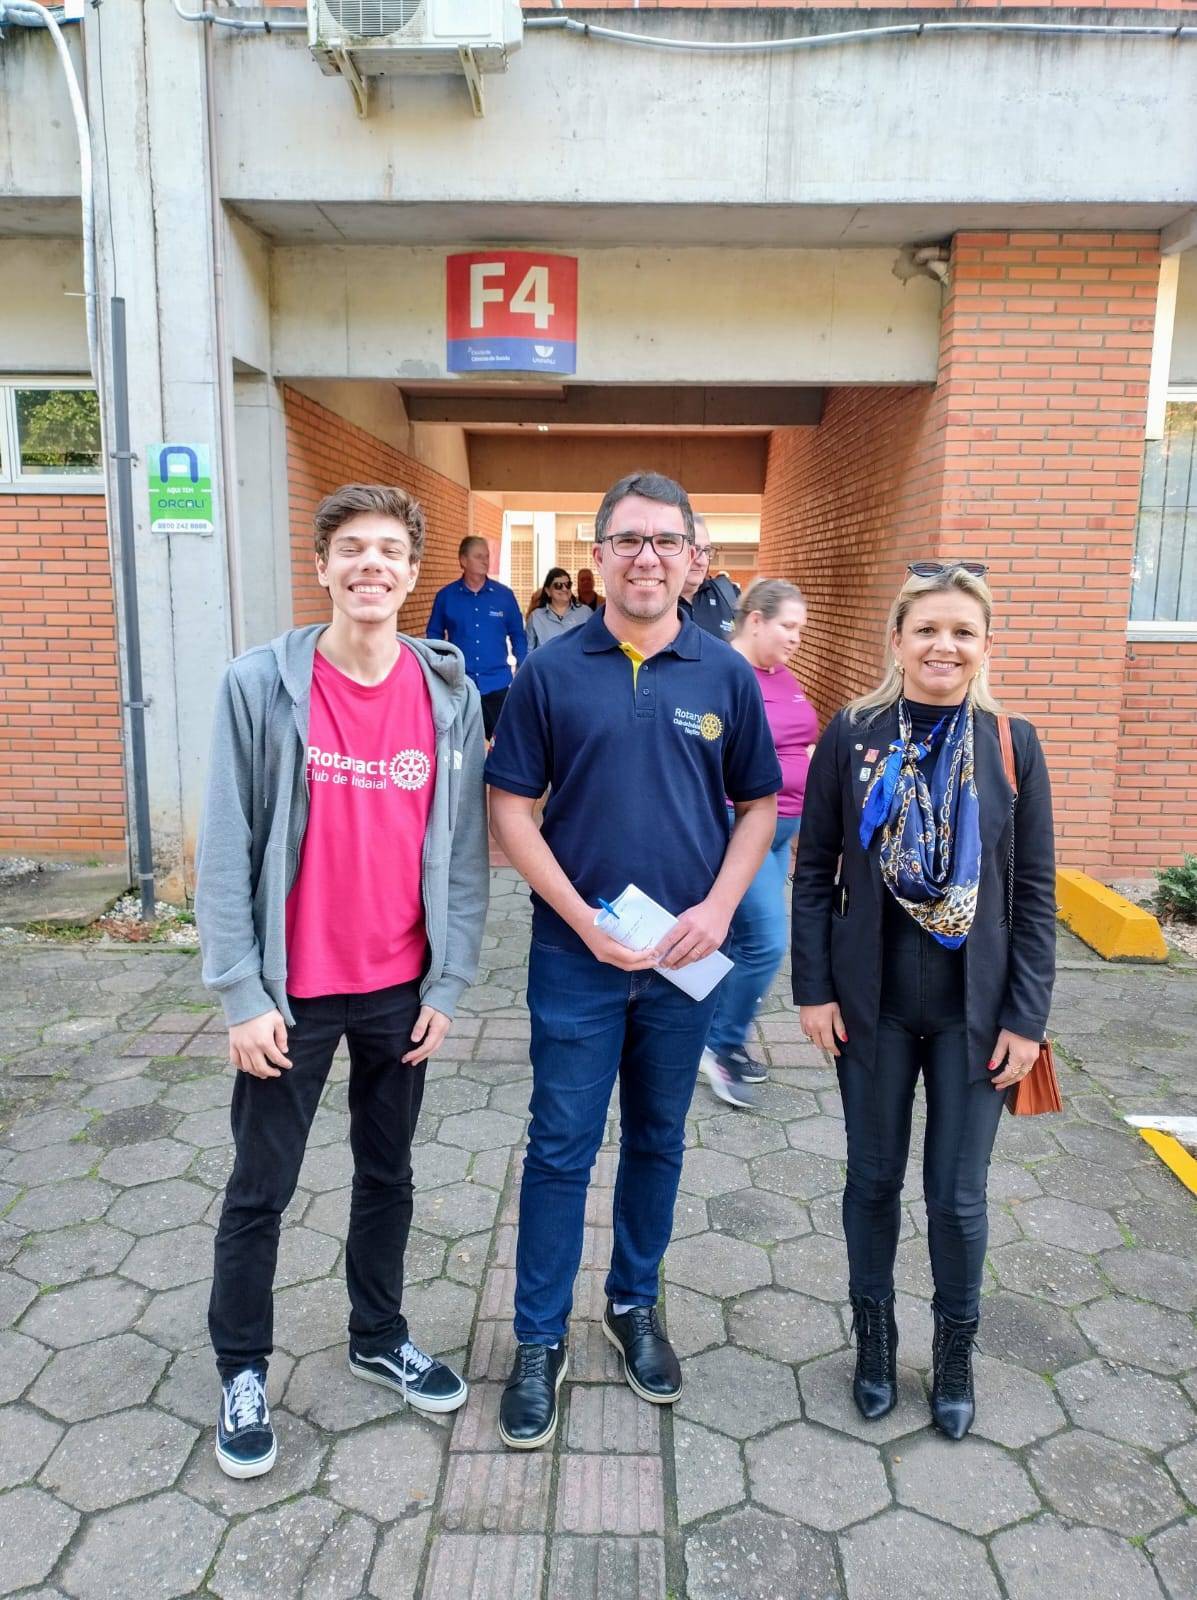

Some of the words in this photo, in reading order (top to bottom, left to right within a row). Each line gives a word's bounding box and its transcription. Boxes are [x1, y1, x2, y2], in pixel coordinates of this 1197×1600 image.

[470, 262, 555, 329] F4
[158, 499, 205, 509] ORCALI
[674, 707, 702, 723] Rotary
[307, 746, 387, 776] Rotaract
[332, 772, 348, 785] de
